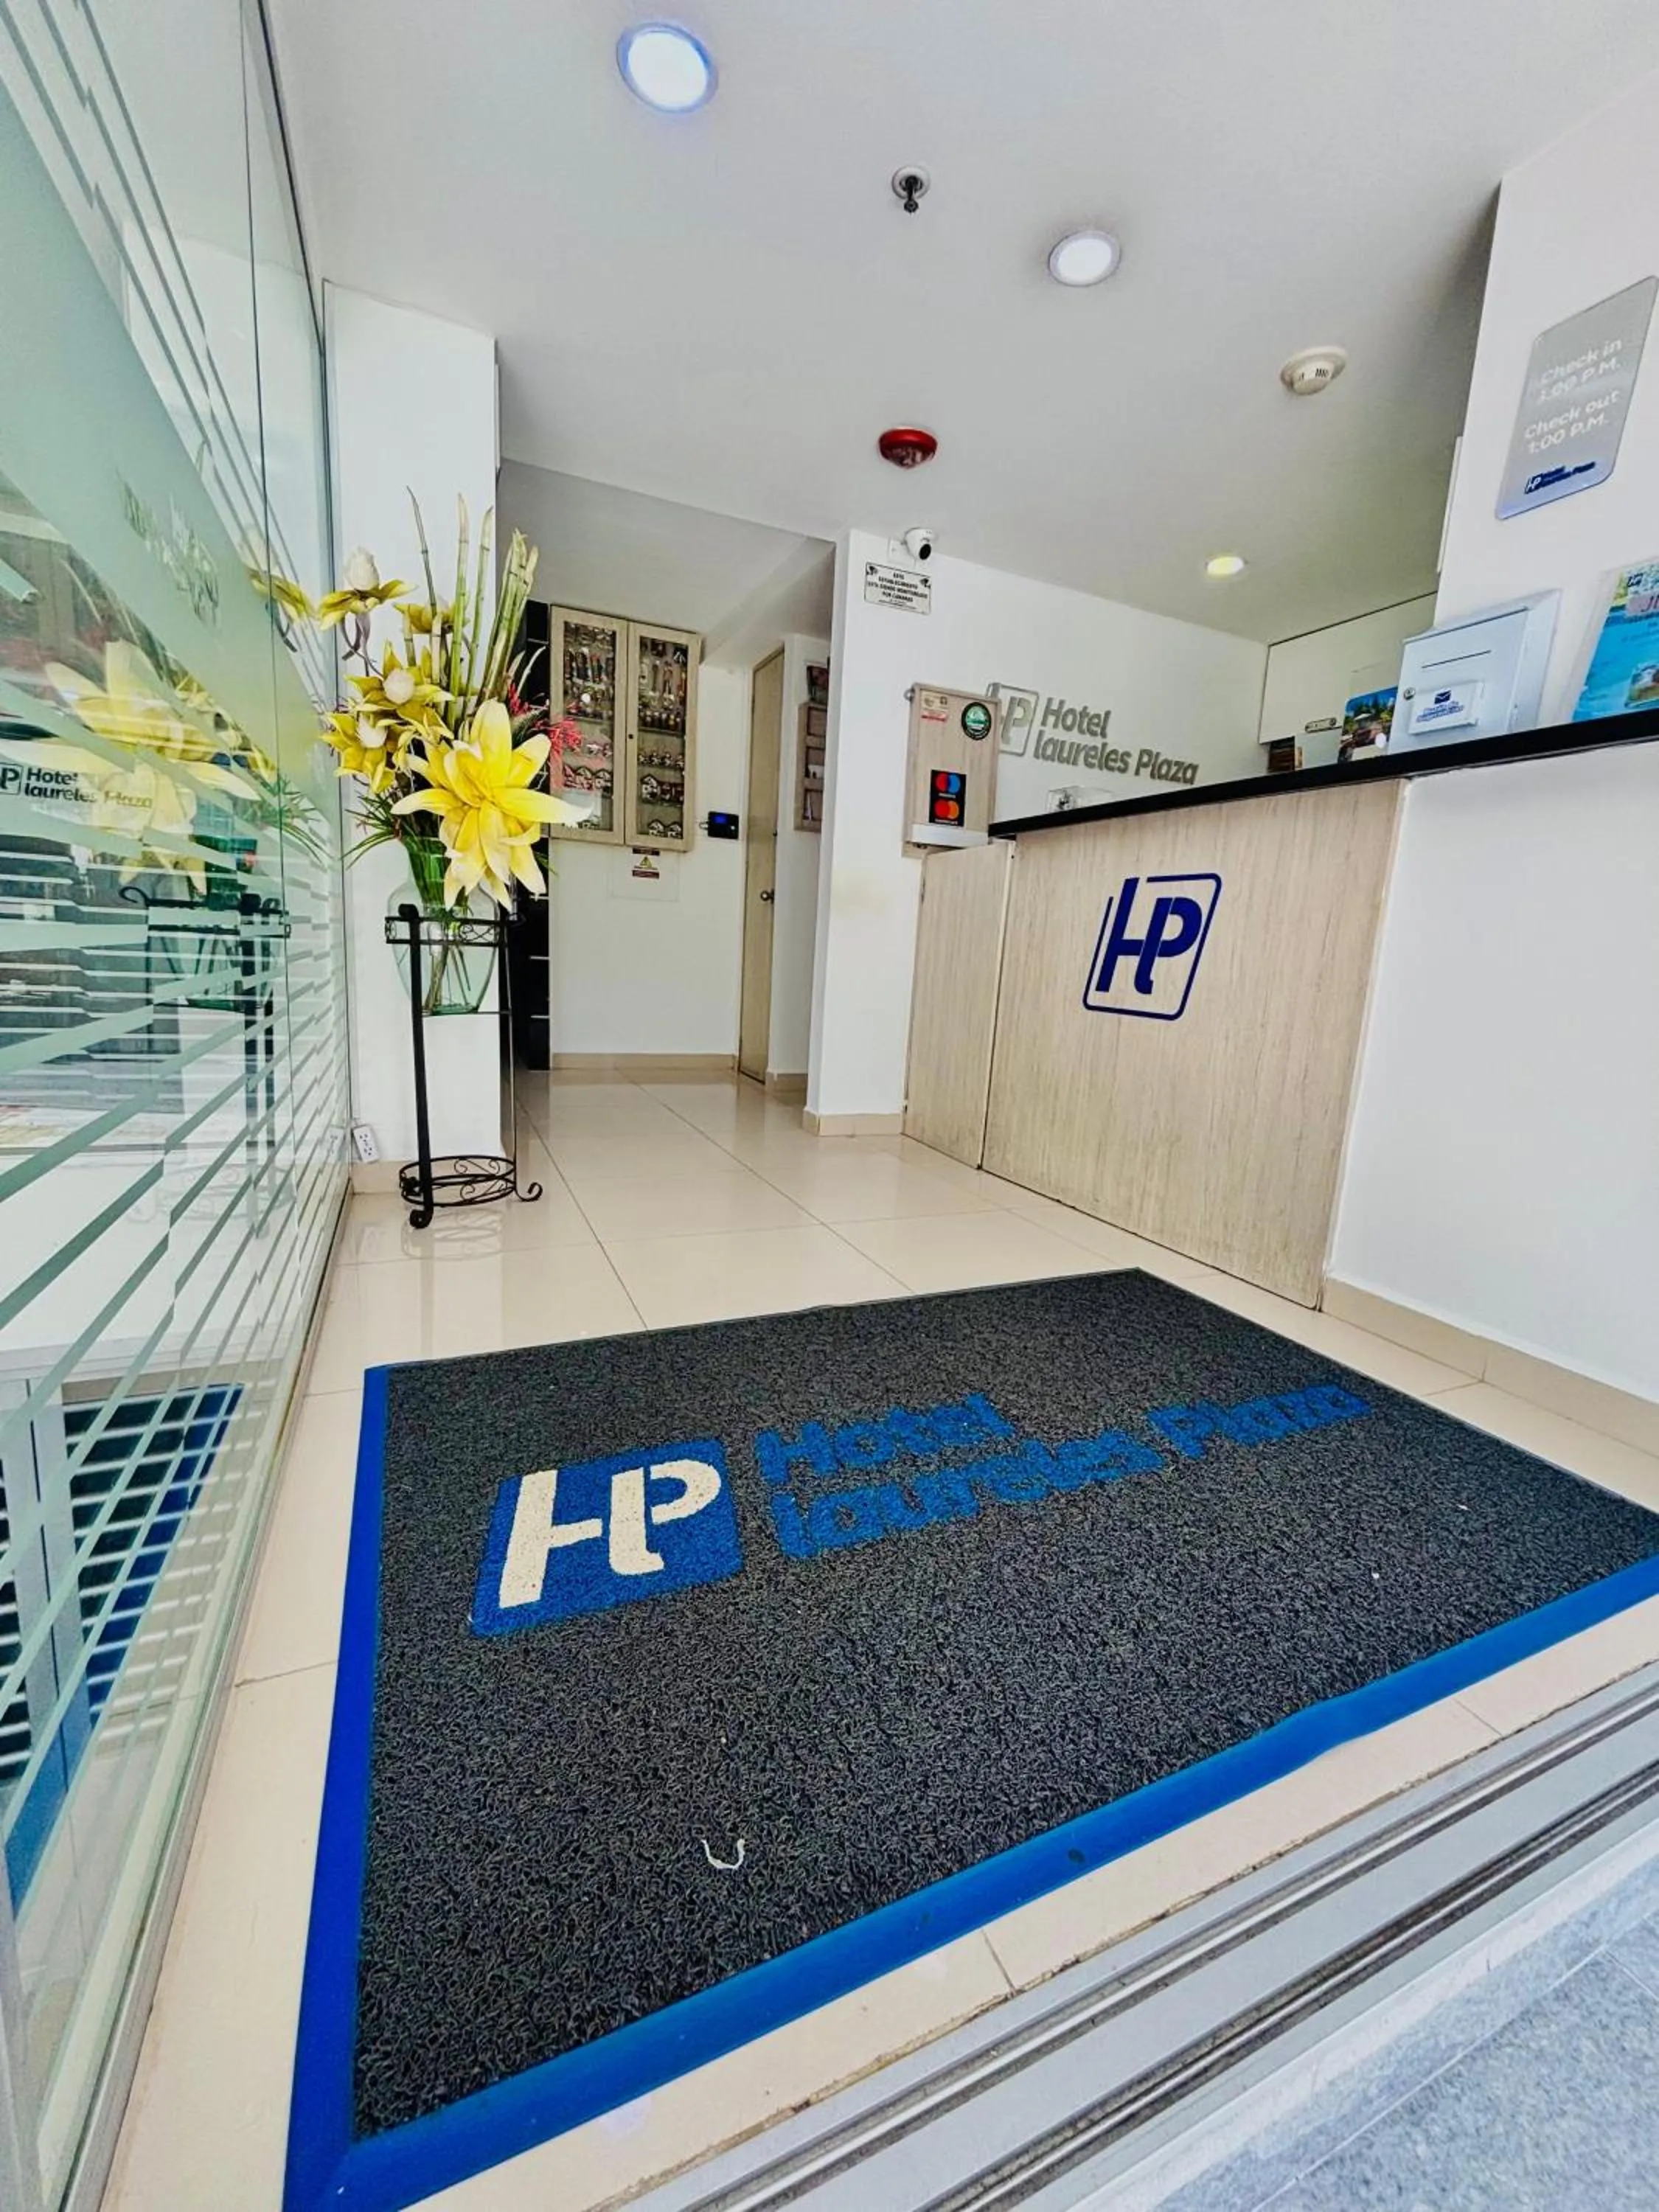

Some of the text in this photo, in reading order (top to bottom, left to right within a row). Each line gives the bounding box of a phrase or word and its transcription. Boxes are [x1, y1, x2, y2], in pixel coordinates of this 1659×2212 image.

[1603, 340, 1621, 357] in
[1525, 390, 1619, 439] Check out
[1041, 698, 1111, 739] Hotel
[1135, 748, 1199, 785] Plaza
[754, 1392, 1015, 1484] Hotel
[1147, 1384, 1373, 1459] Plaza
